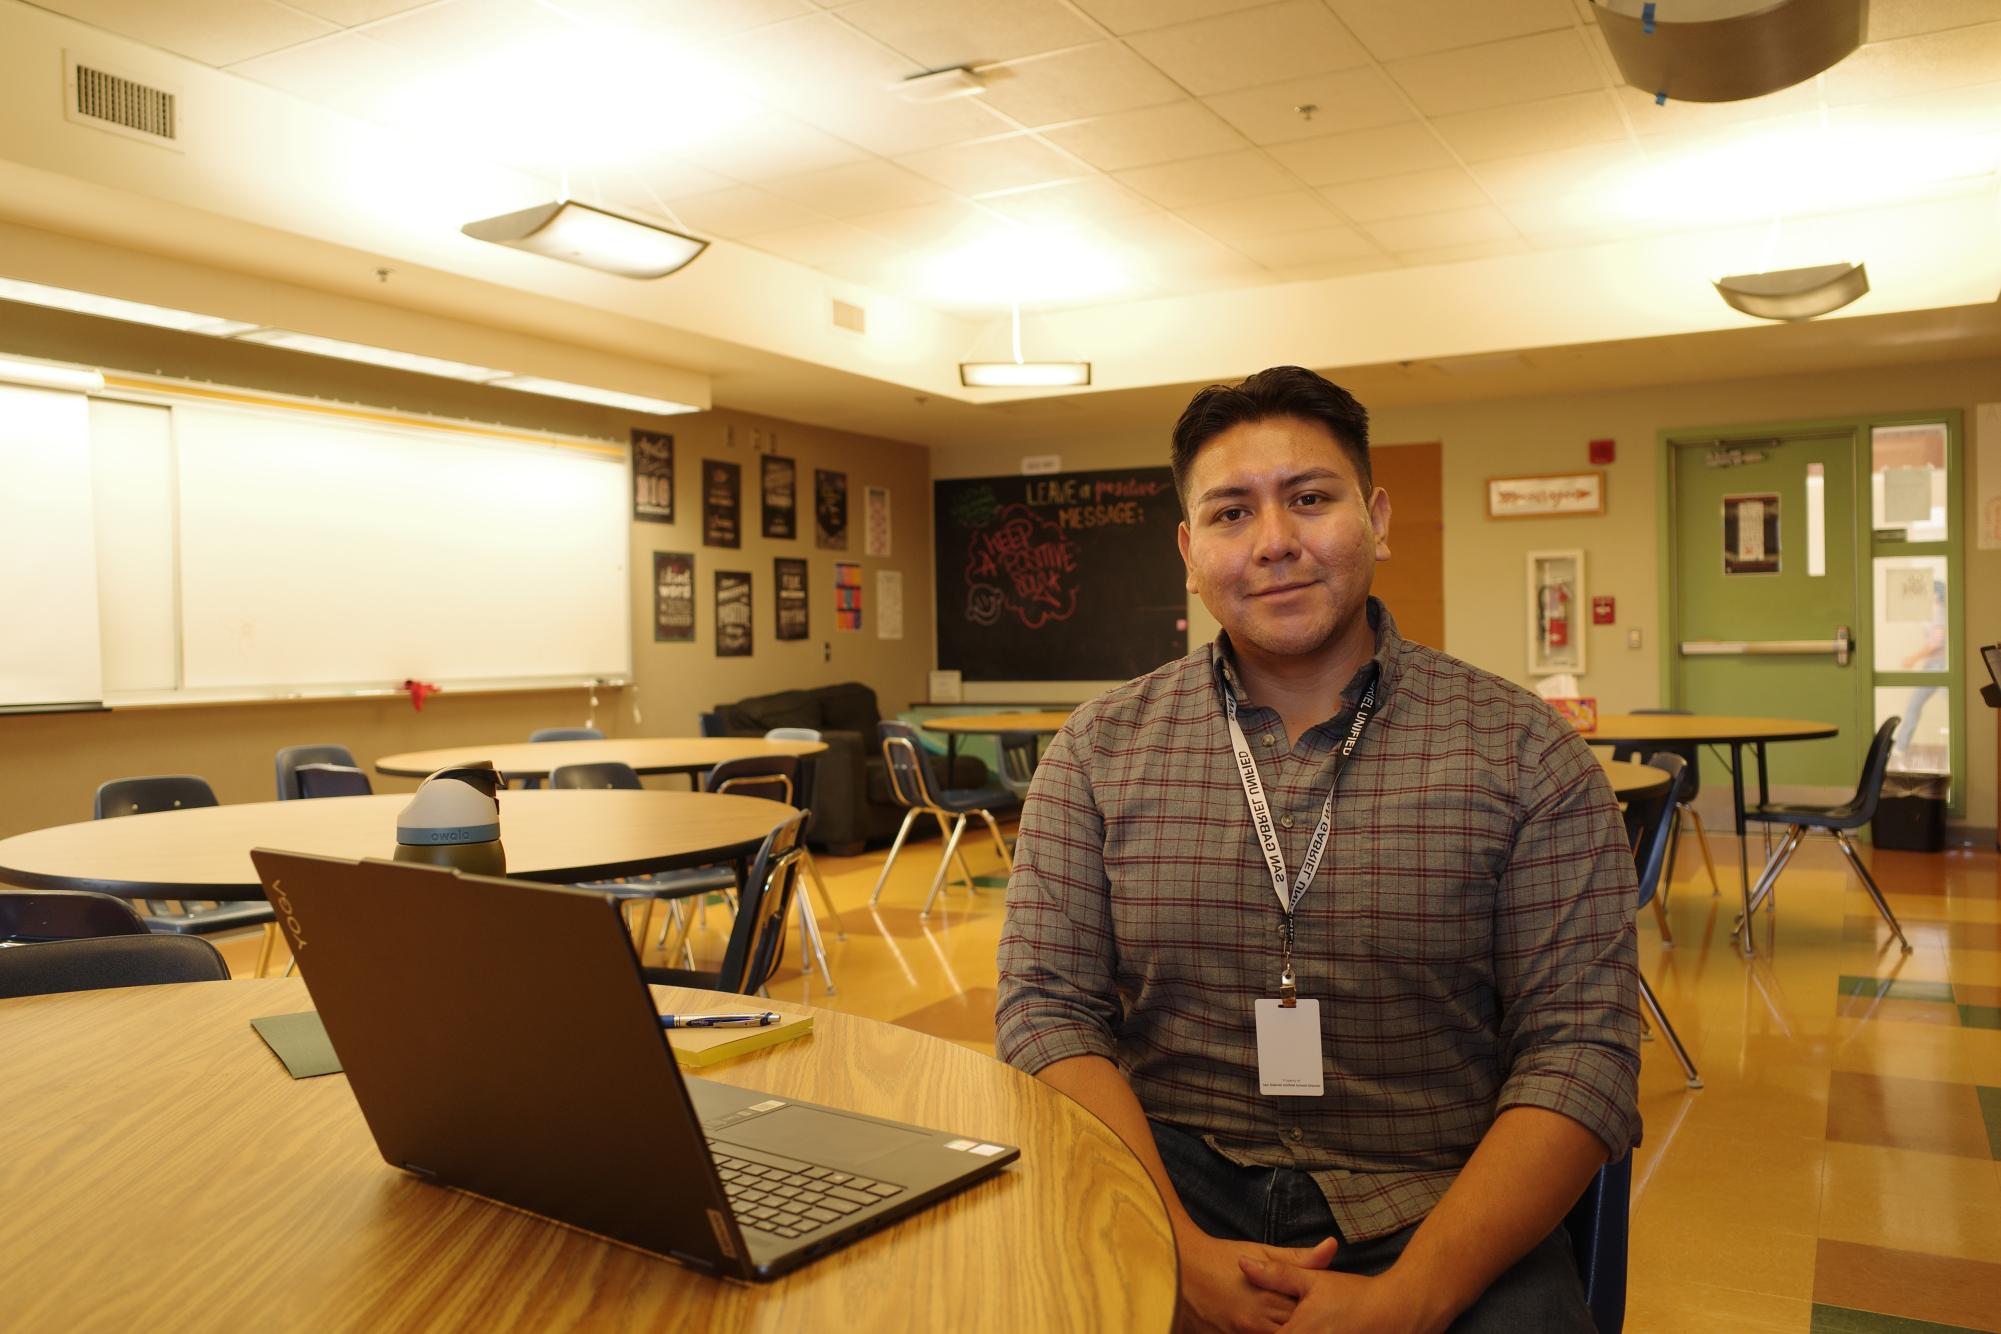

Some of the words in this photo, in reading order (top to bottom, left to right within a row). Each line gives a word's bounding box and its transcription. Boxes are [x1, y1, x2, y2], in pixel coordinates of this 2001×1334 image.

[1026, 480, 1077, 506] LEAVE
[1094, 477, 1171, 502] positive
[1059, 502, 1145, 529] MESSAGE:
[1342, 711, 1368, 757] UNIFIED
[431, 829, 471, 841] owala
[273, 880, 308, 950] YOGA
